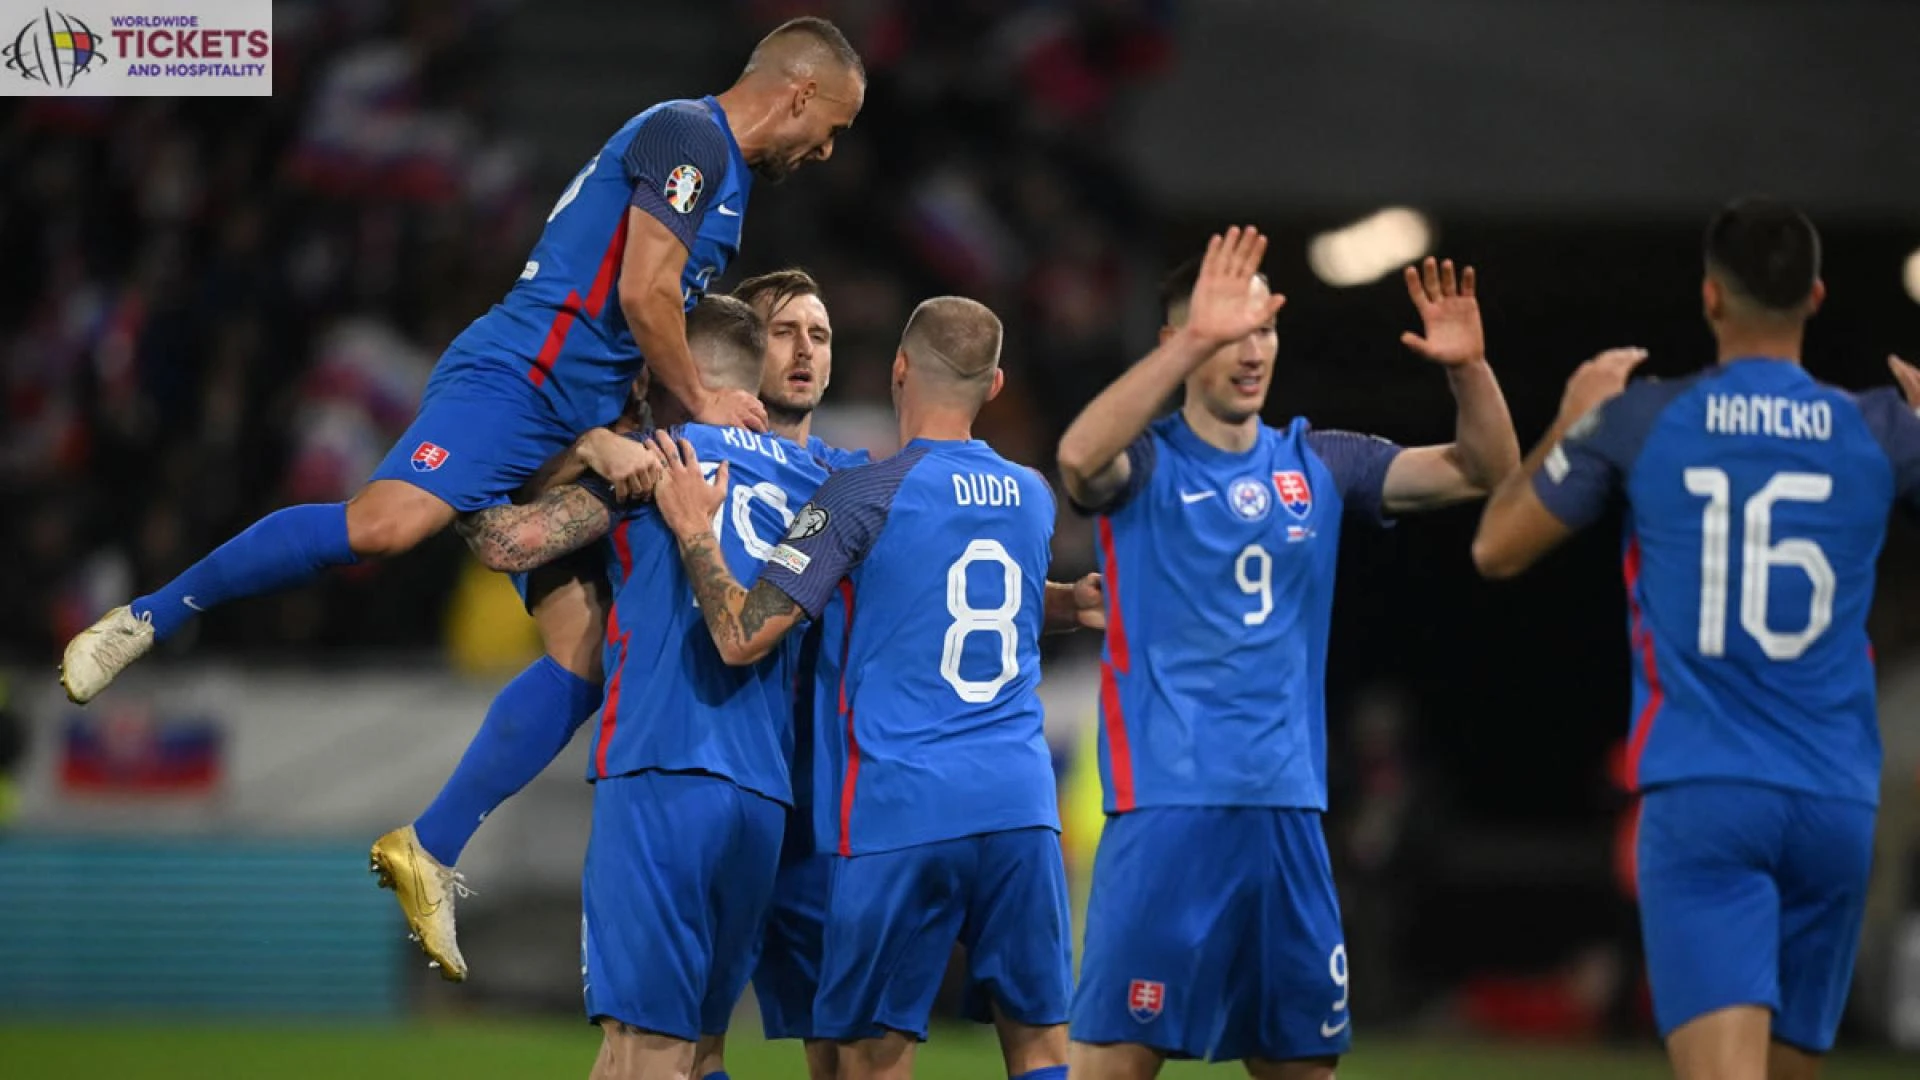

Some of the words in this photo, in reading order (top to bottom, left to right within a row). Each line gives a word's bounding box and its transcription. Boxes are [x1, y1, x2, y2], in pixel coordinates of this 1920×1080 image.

[1706, 393, 1832, 441] HANCKO
[951, 473, 1021, 507] DUDA
[1234, 543, 1273, 625] 9
[1683, 466, 1837, 661] 16
[940, 538, 1022, 703] 8
[1328, 943, 1349, 1012] 9
